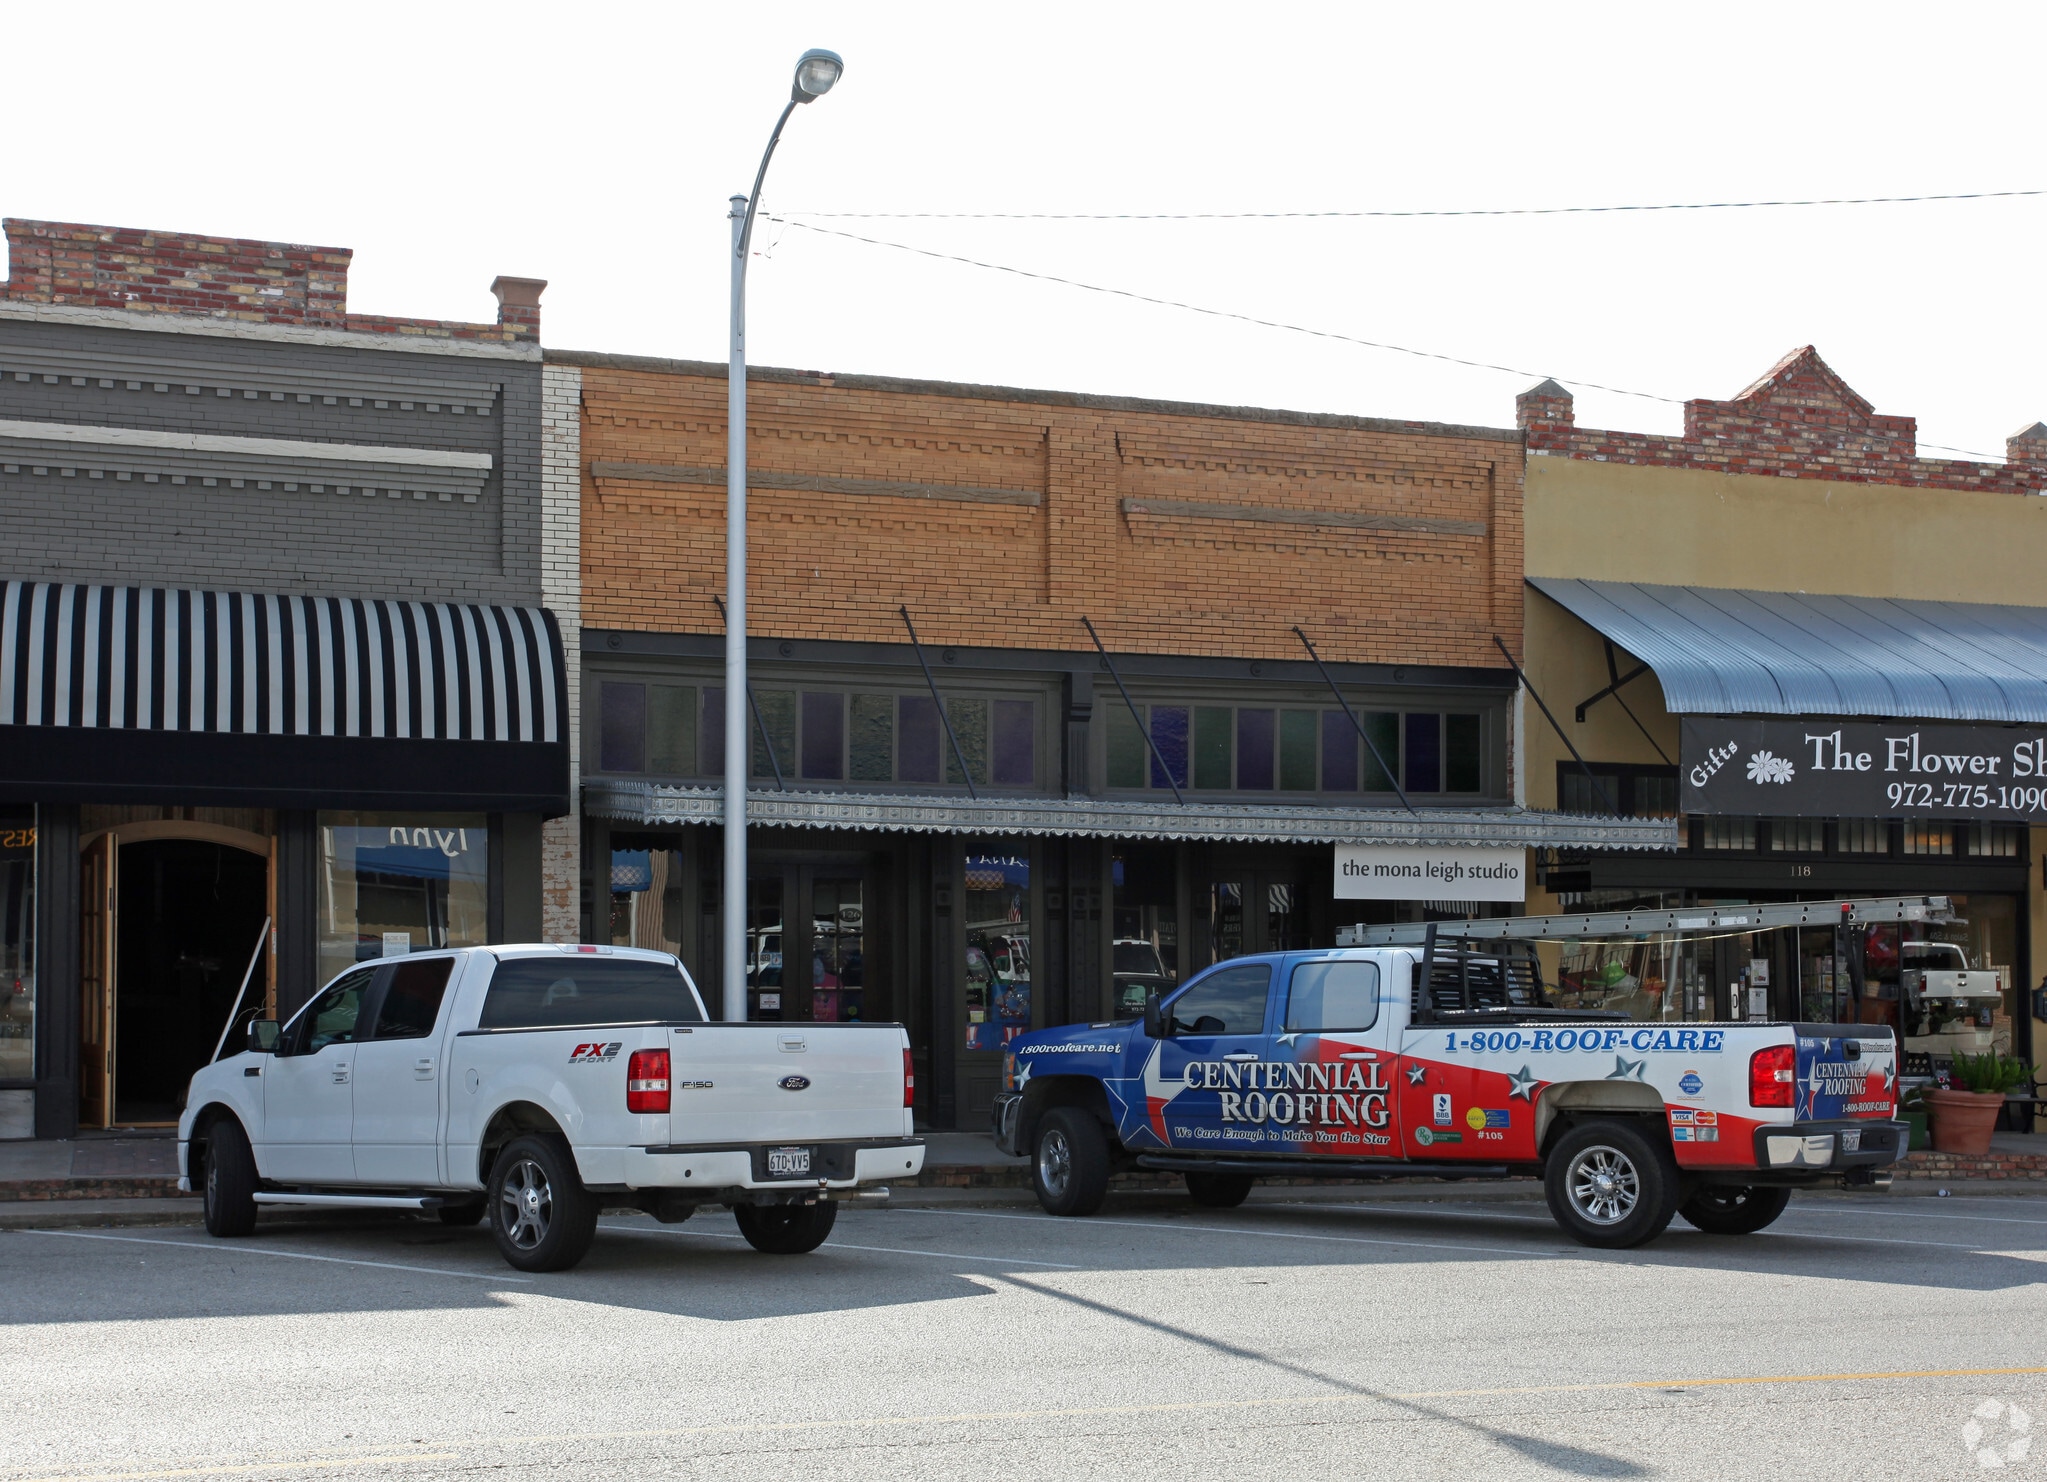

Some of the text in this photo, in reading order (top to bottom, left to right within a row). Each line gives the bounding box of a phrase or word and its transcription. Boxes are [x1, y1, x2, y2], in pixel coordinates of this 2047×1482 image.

[1805, 730, 1872, 772] The
[1884, 732, 2001, 774] Flower
[1690, 740, 1738, 788] Gifts
[1342, 859, 1519, 882] the mona leigh studio
[1791, 866, 1811, 877] 118
[841, 910, 861, 919] 126
[1445, 1029, 1725, 1052] 1-800-ROOF-CARE
[1800, 1038, 1815, 1047] #105
[570, 1042, 623, 1057] FX2
[1020, 1043, 1121, 1054] 1800roofcare.net
[568, 1056, 616, 1064] SPORT
[1183, 1061, 1389, 1090] CENTENNIAL
[1816, 1062, 1867, 1078] CENTENNIAL
[681, 1081, 714, 1089] F-150
[1824, 1078, 1867, 1096] ROOFING
[1218, 1091, 1389, 1127] ROOFING
[1842, 1101, 1890, 1113] 1-800-ROOF-CARE
[1174, 1127, 1390, 1144] We Care Enough to Make You the Star
[1478, 1131, 1503, 1140] #105
